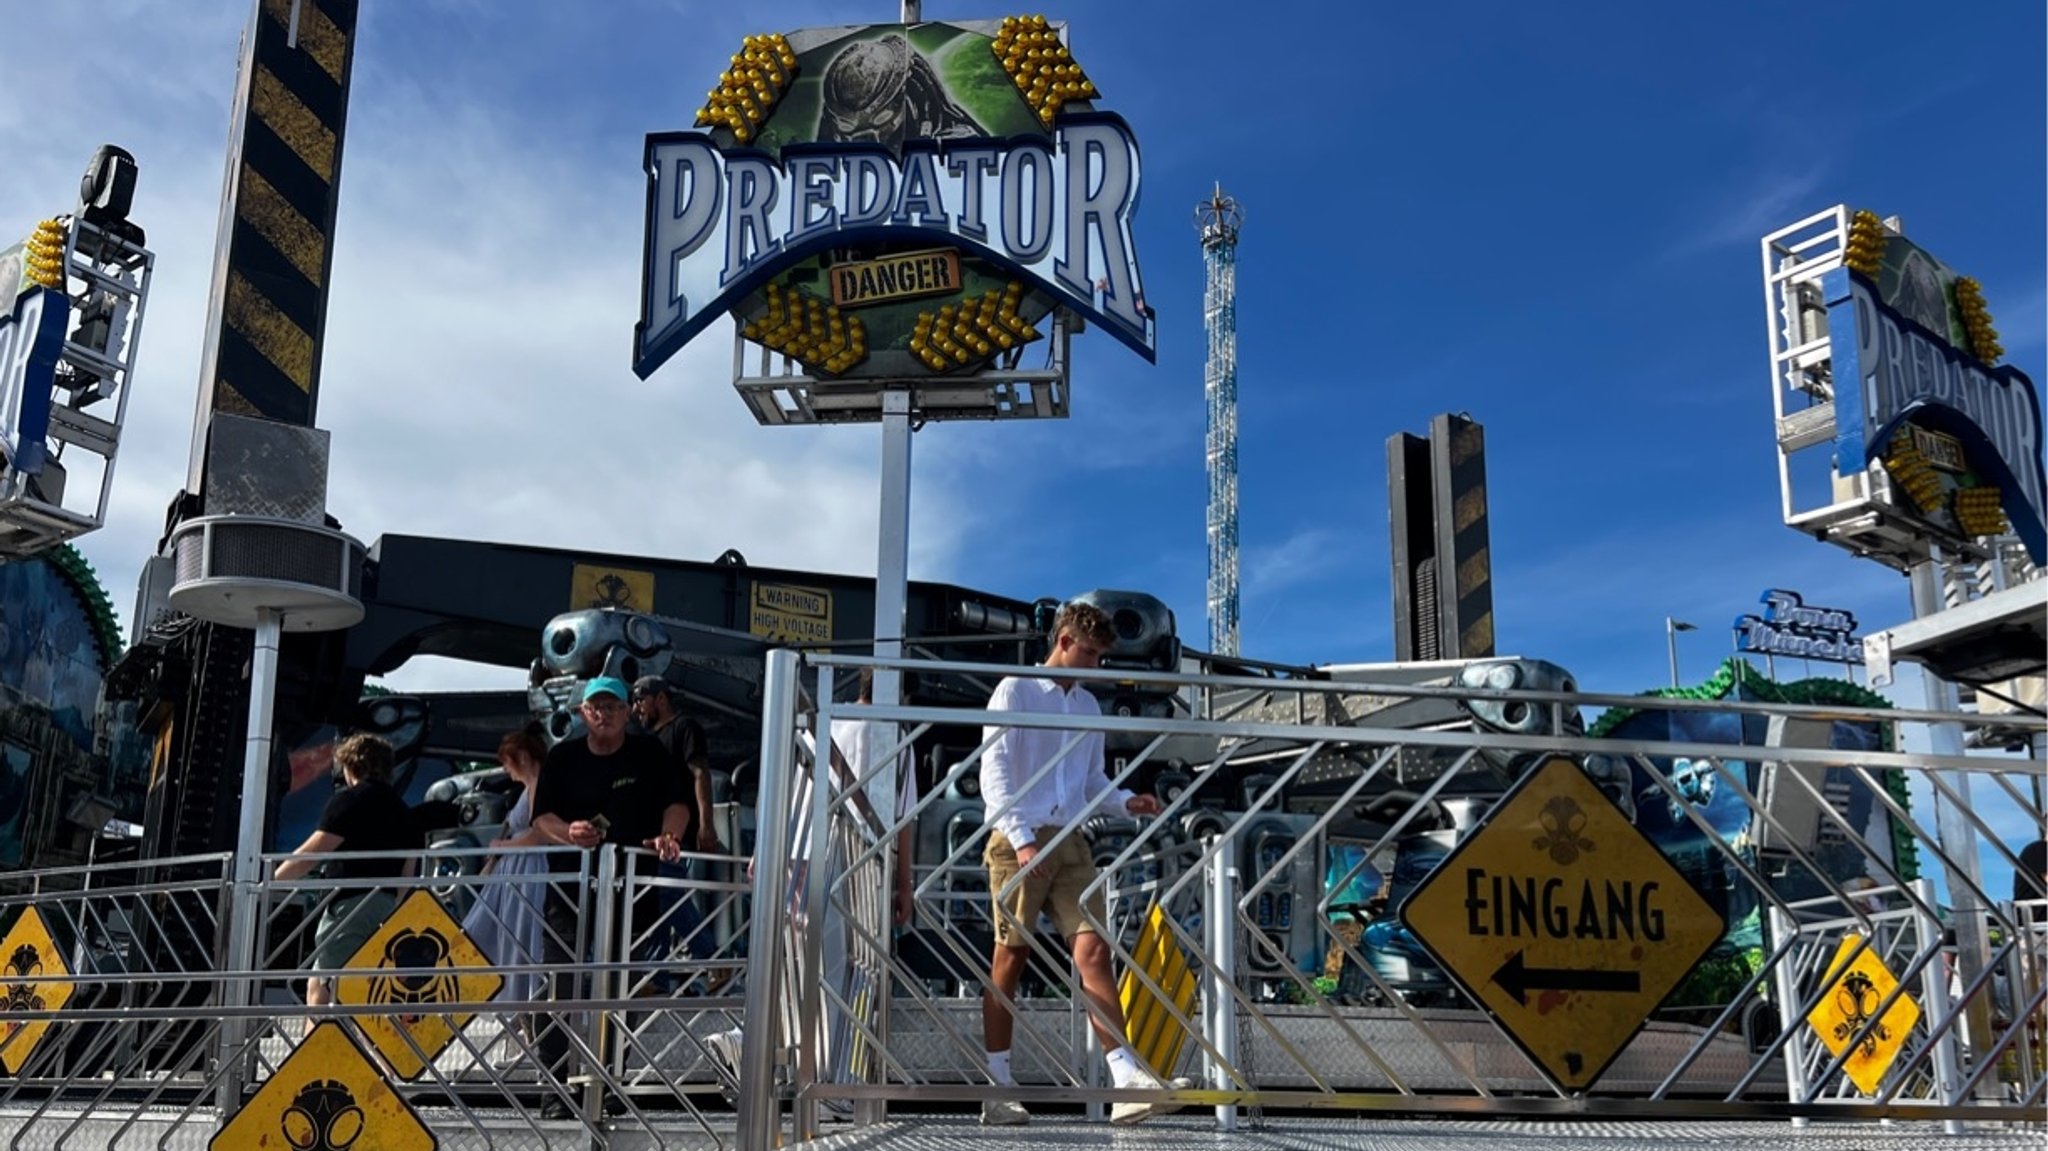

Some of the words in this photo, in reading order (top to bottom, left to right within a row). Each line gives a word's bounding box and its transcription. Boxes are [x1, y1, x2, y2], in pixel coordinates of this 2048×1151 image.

[638, 120, 1150, 354] PREDATOR
[840, 256, 950, 301] DANGER
[1853, 278, 2046, 527] PREDATOR
[754, 611, 780, 630] HIGH
[783, 618, 829, 639] VOLTAGE
[766, 588, 820, 612] WARNING
[1464, 867, 1667, 942] EINGANG
